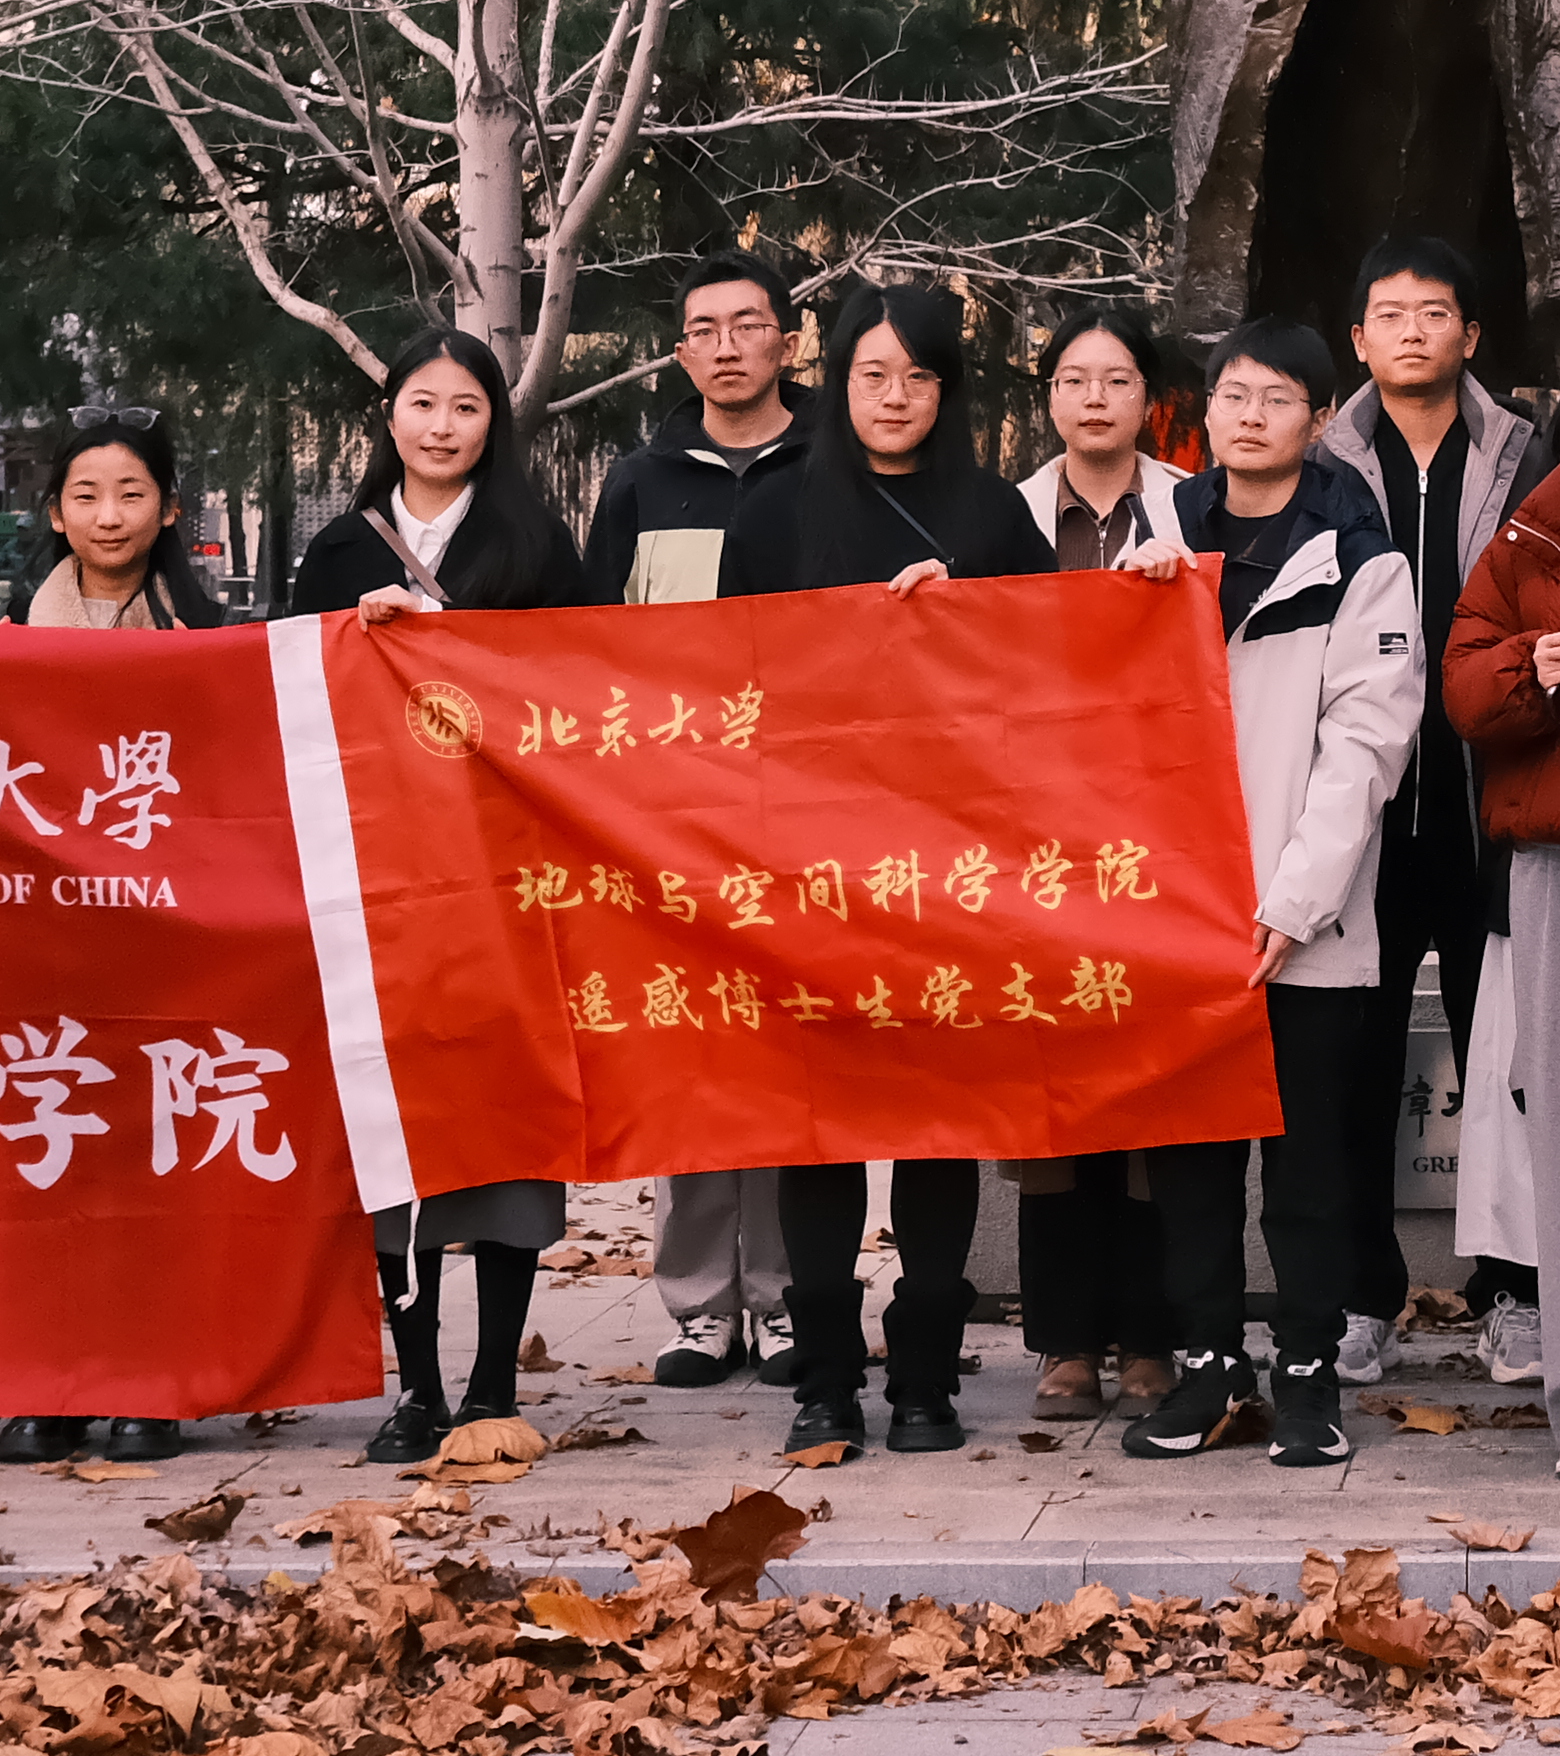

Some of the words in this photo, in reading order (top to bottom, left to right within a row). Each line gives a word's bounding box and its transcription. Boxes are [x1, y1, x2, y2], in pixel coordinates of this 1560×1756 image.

[51, 875, 179, 908] CHINA
[514, 838, 1160, 930] 地球与空间科学学院
[568, 954, 1133, 1034] 遥感博士生党支部
